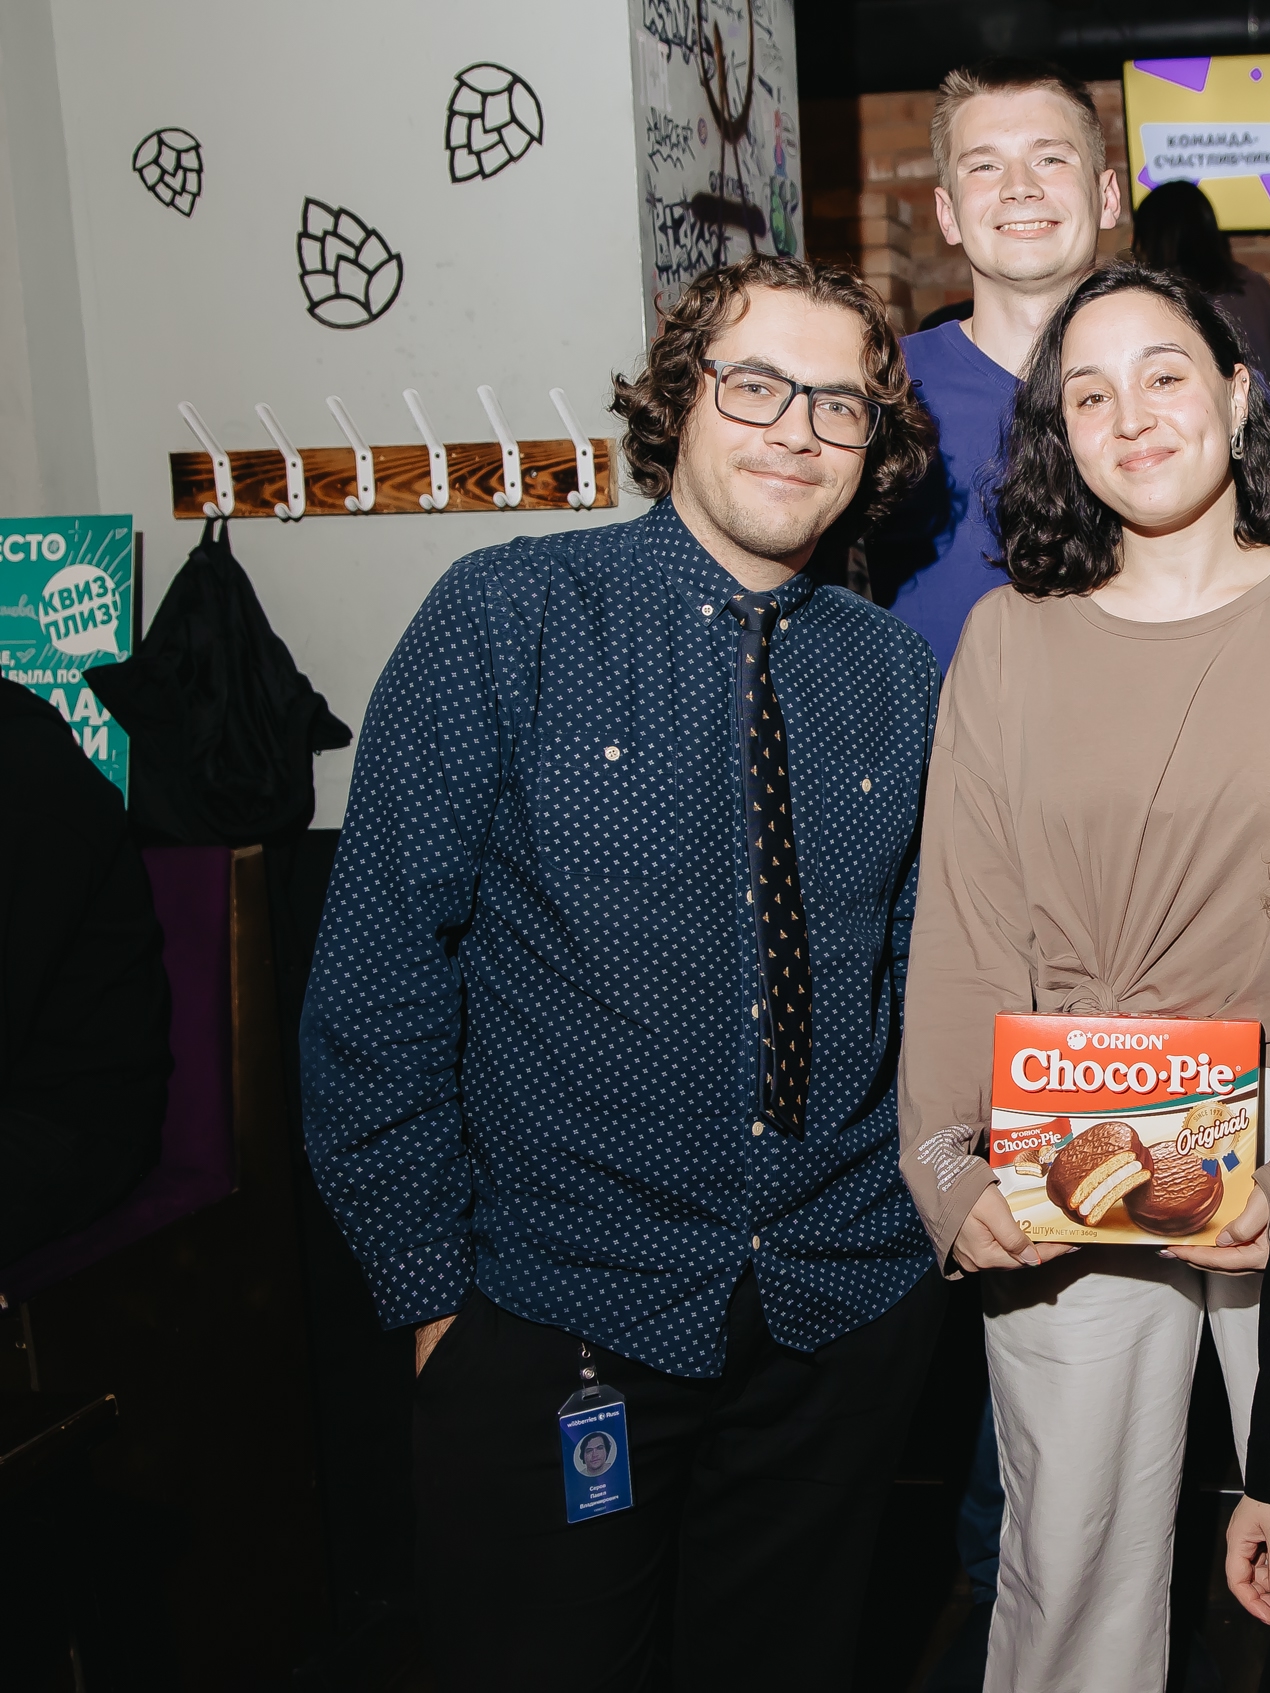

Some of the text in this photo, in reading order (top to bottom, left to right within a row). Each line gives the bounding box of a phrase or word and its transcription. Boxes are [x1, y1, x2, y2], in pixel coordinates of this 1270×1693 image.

[0, 532, 67, 562] СТО
[1193, 1109, 1208, 1123] SINCE
[1176, 1108, 1249, 1156] Original
[567, 1416, 597, 1428] wildberries
